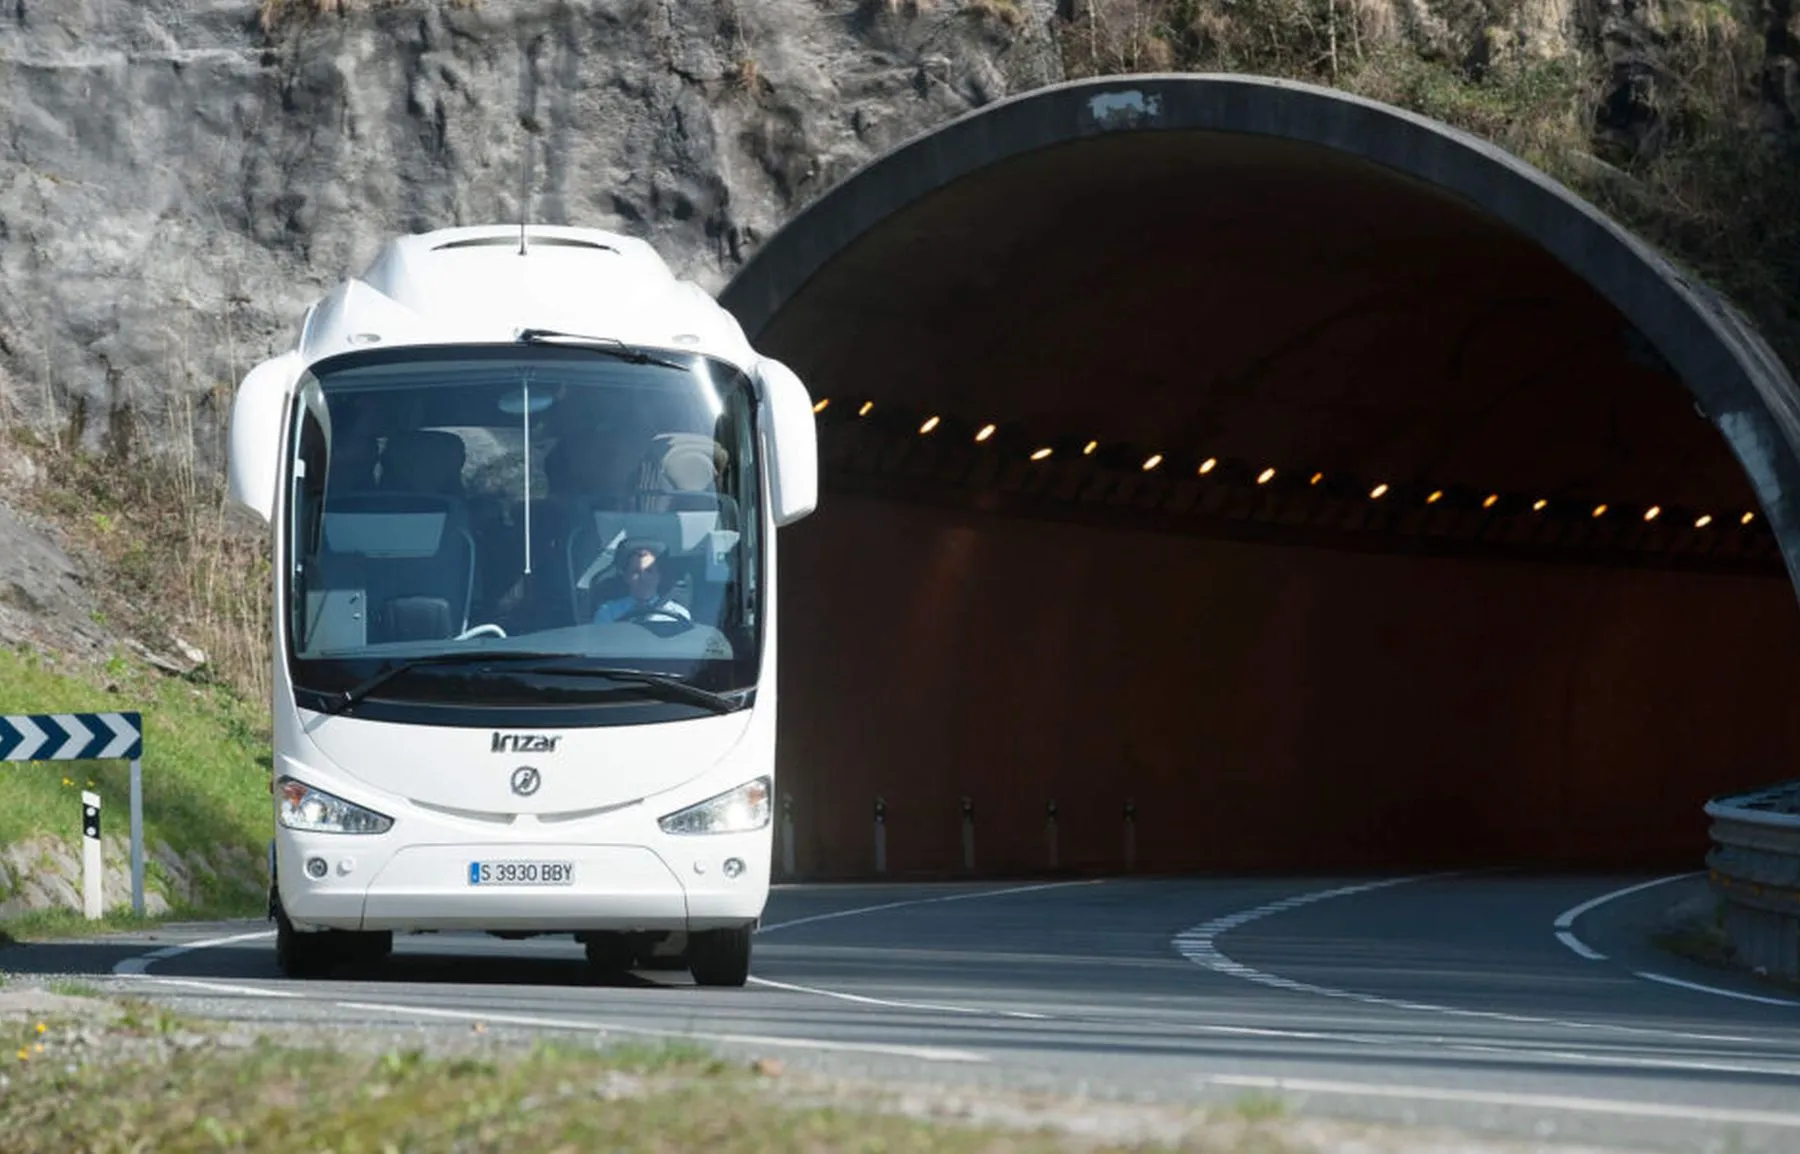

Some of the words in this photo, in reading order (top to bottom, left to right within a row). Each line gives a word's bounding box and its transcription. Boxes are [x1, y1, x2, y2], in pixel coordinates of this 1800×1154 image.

[491, 732, 562, 752] Irizar
[481, 864, 491, 881] S
[496, 864, 538, 881] 3930
[542, 864, 572, 881] BBY
